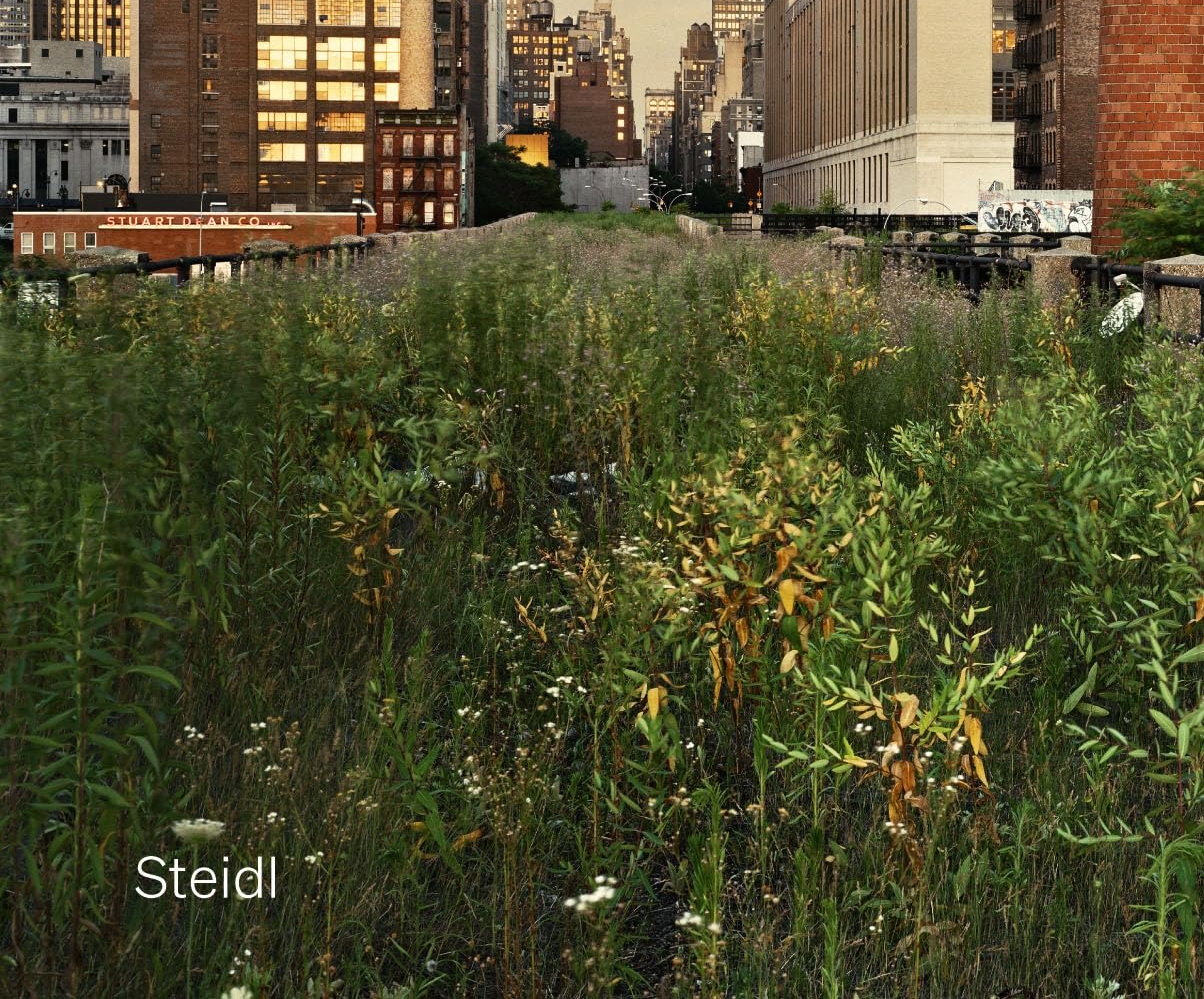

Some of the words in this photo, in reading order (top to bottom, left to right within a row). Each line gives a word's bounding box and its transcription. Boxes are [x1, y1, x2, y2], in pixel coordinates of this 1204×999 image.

[107, 216, 175, 226] STUART
[183, 216, 229, 226] DEAN
[238, 216, 260, 226] CO
